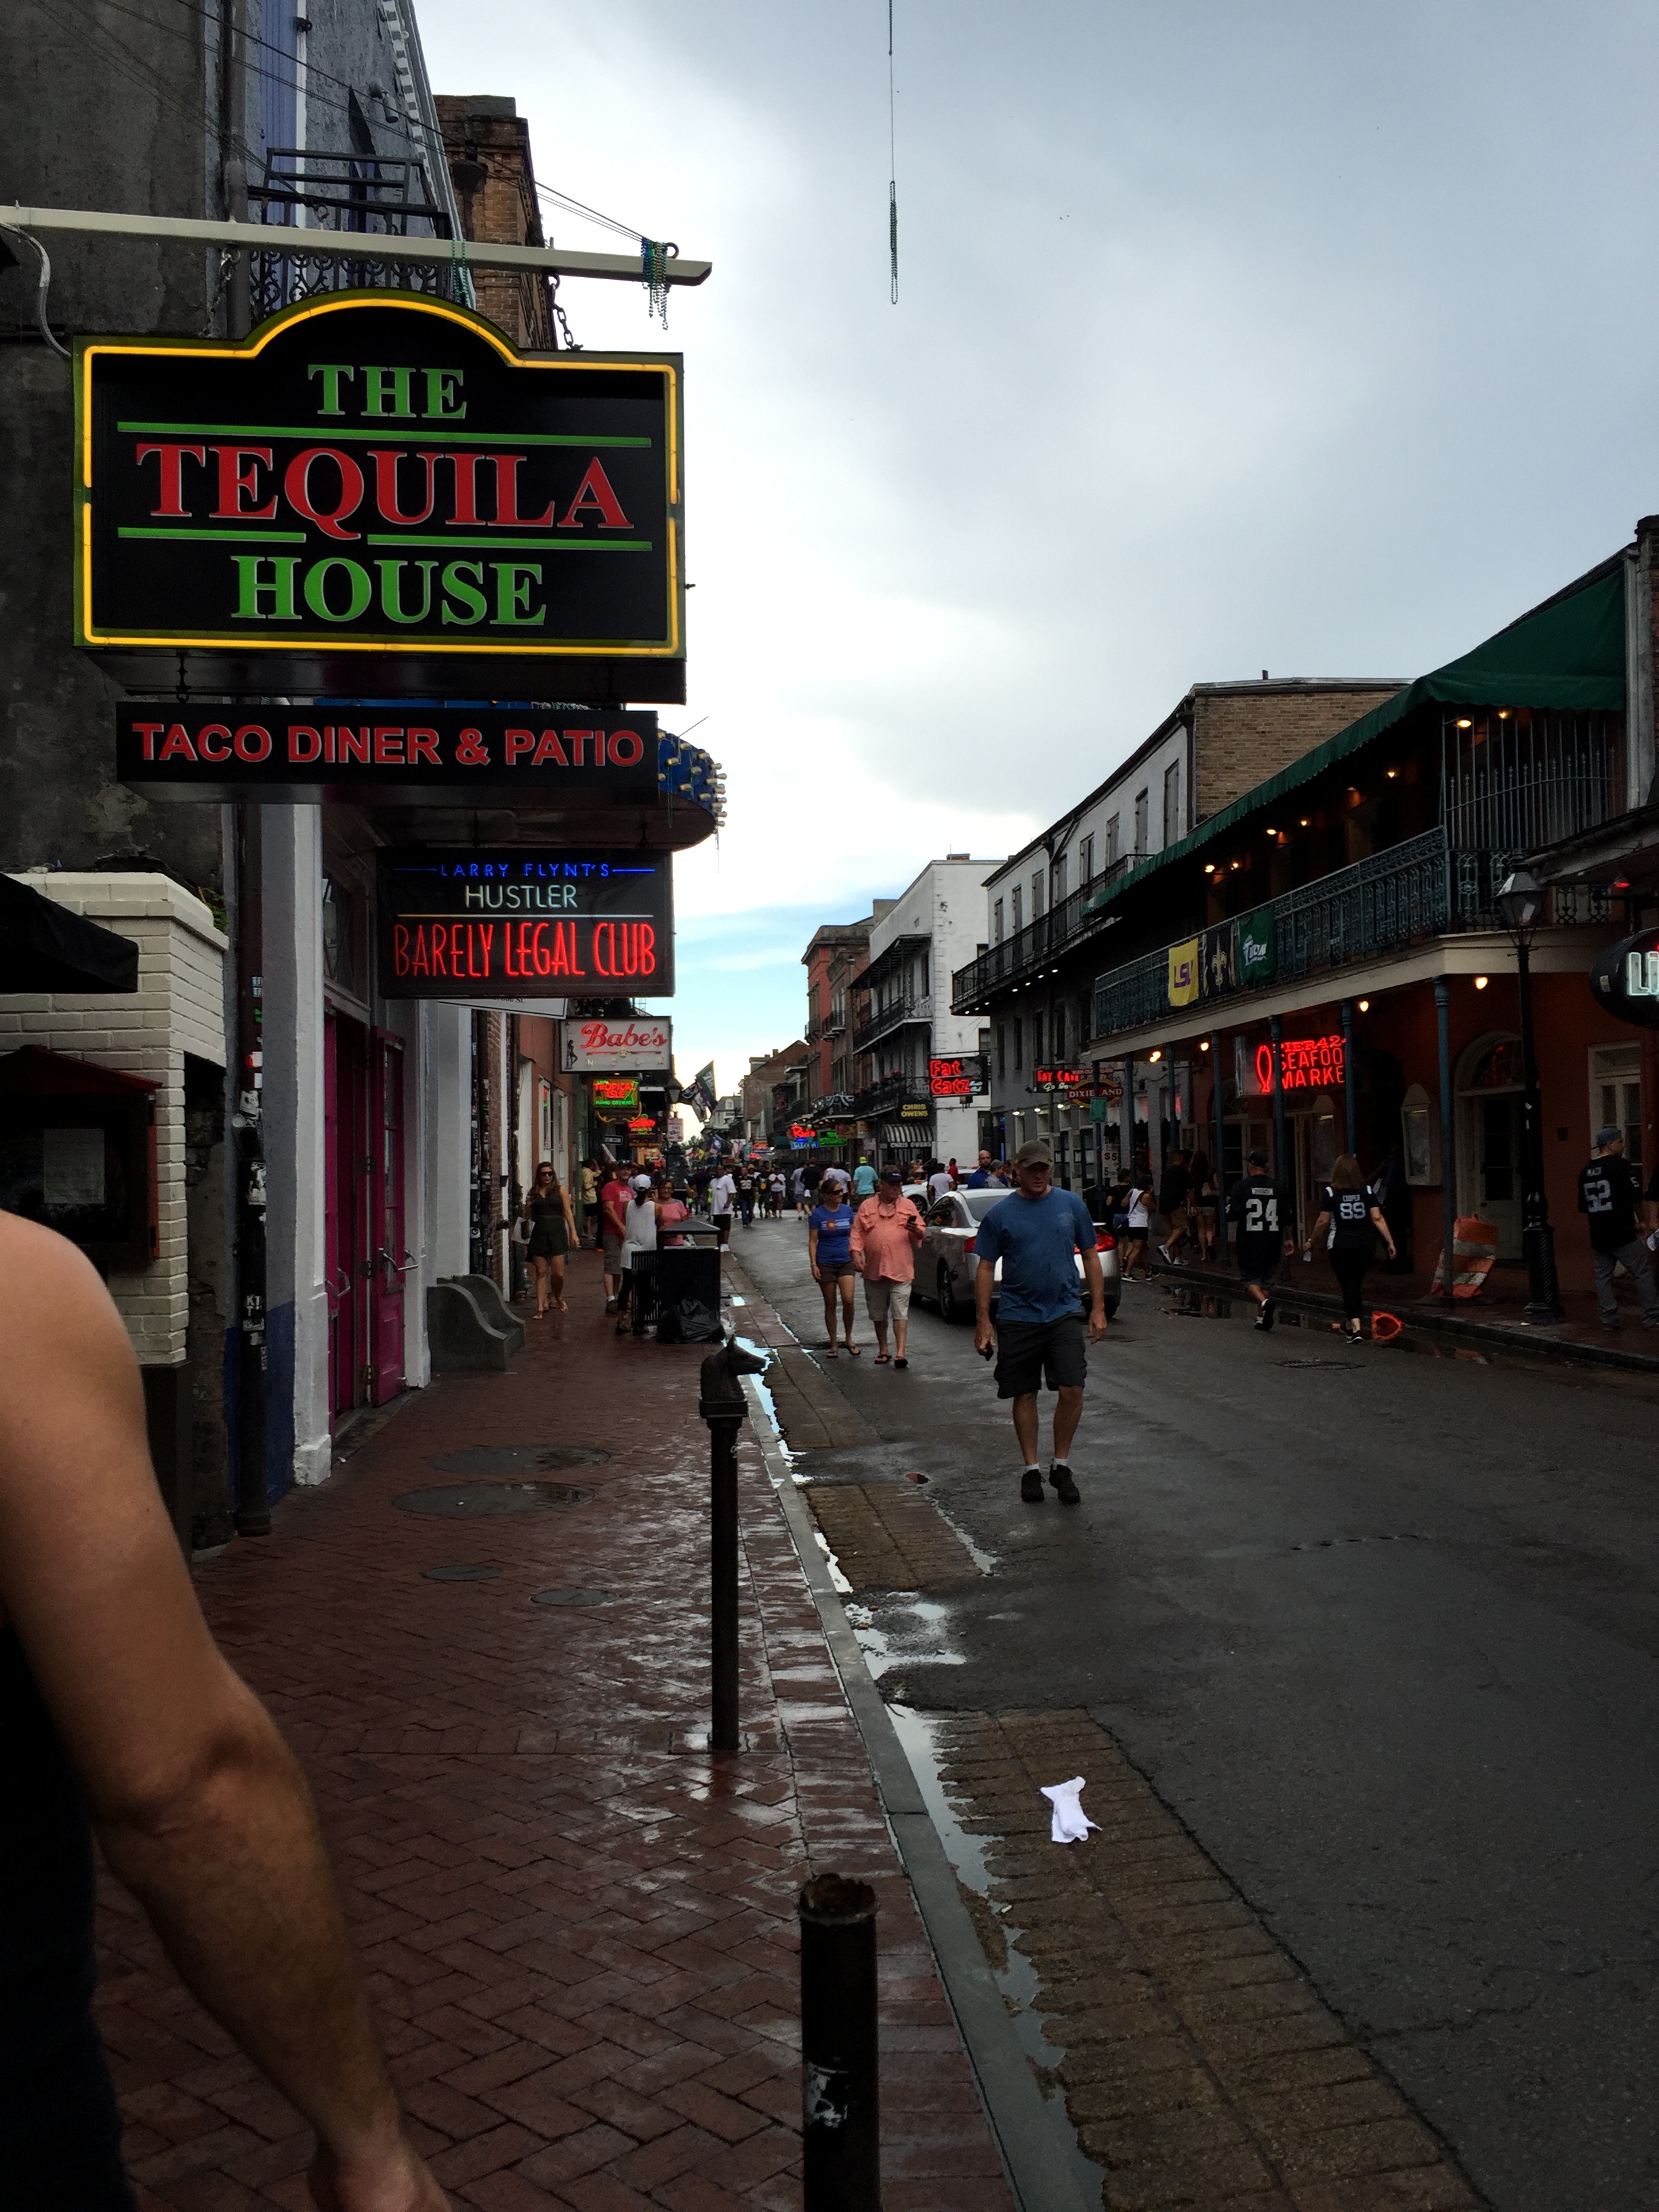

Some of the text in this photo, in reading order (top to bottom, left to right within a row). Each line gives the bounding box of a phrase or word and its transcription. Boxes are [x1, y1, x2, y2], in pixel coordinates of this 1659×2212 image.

[308, 364, 466, 419] THE
[136, 443, 634, 540] TEQUILA
[230, 555, 547, 625] HOUSE
[131, 722, 644, 767] TACO DINER & PATIO
[441, 863, 609, 877] LARRY FLYNT'S
[465, 884, 578, 909] HUSTLER
[394, 922, 656, 977] BARELY LEGAL CLUB
[581, 1021, 668, 1048] Babe's
[930, 1060, 962, 1077] Fat
[1281, 1048, 1343, 1071] SEAFOO
[1282, 1065, 1345, 1090] MARKE
[1069, 1088, 1122, 1098] DIXIEAND
[1584, 1179, 1614, 1213] 52
[1246, 1198, 1279, 1232] 24
[1340, 1202, 1366, 1219] 89
